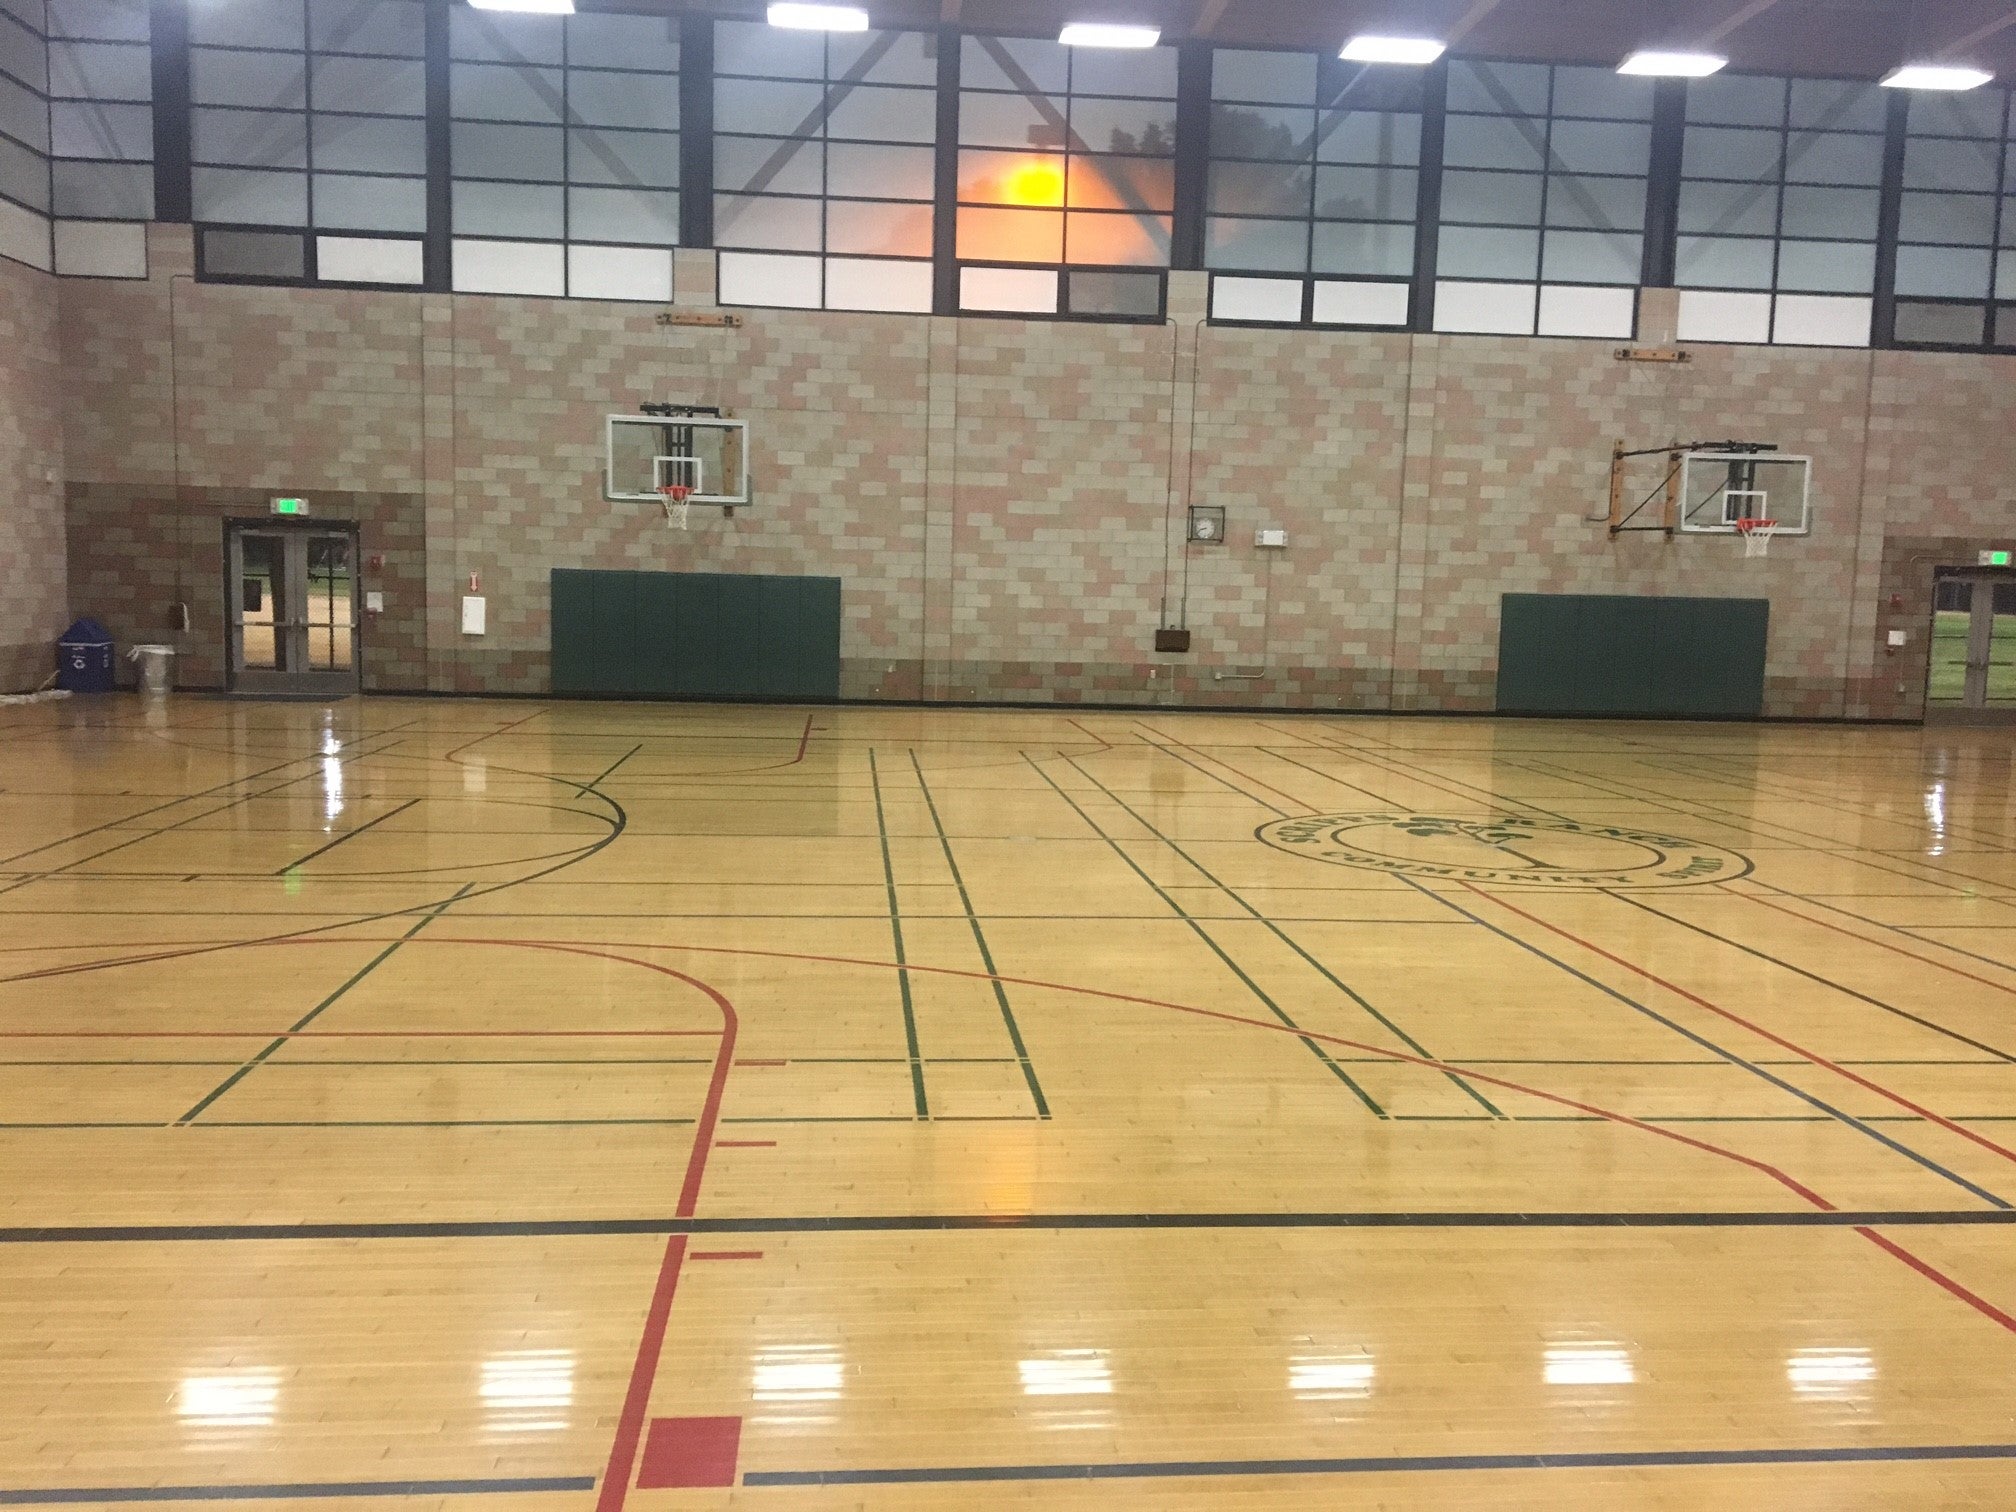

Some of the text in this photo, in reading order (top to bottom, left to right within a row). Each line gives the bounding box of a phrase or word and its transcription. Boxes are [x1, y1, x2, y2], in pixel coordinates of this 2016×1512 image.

[1275, 814, 1697, 849] SCRIPPS RANCH
[1320, 851, 1633, 883] COMMUNITY
